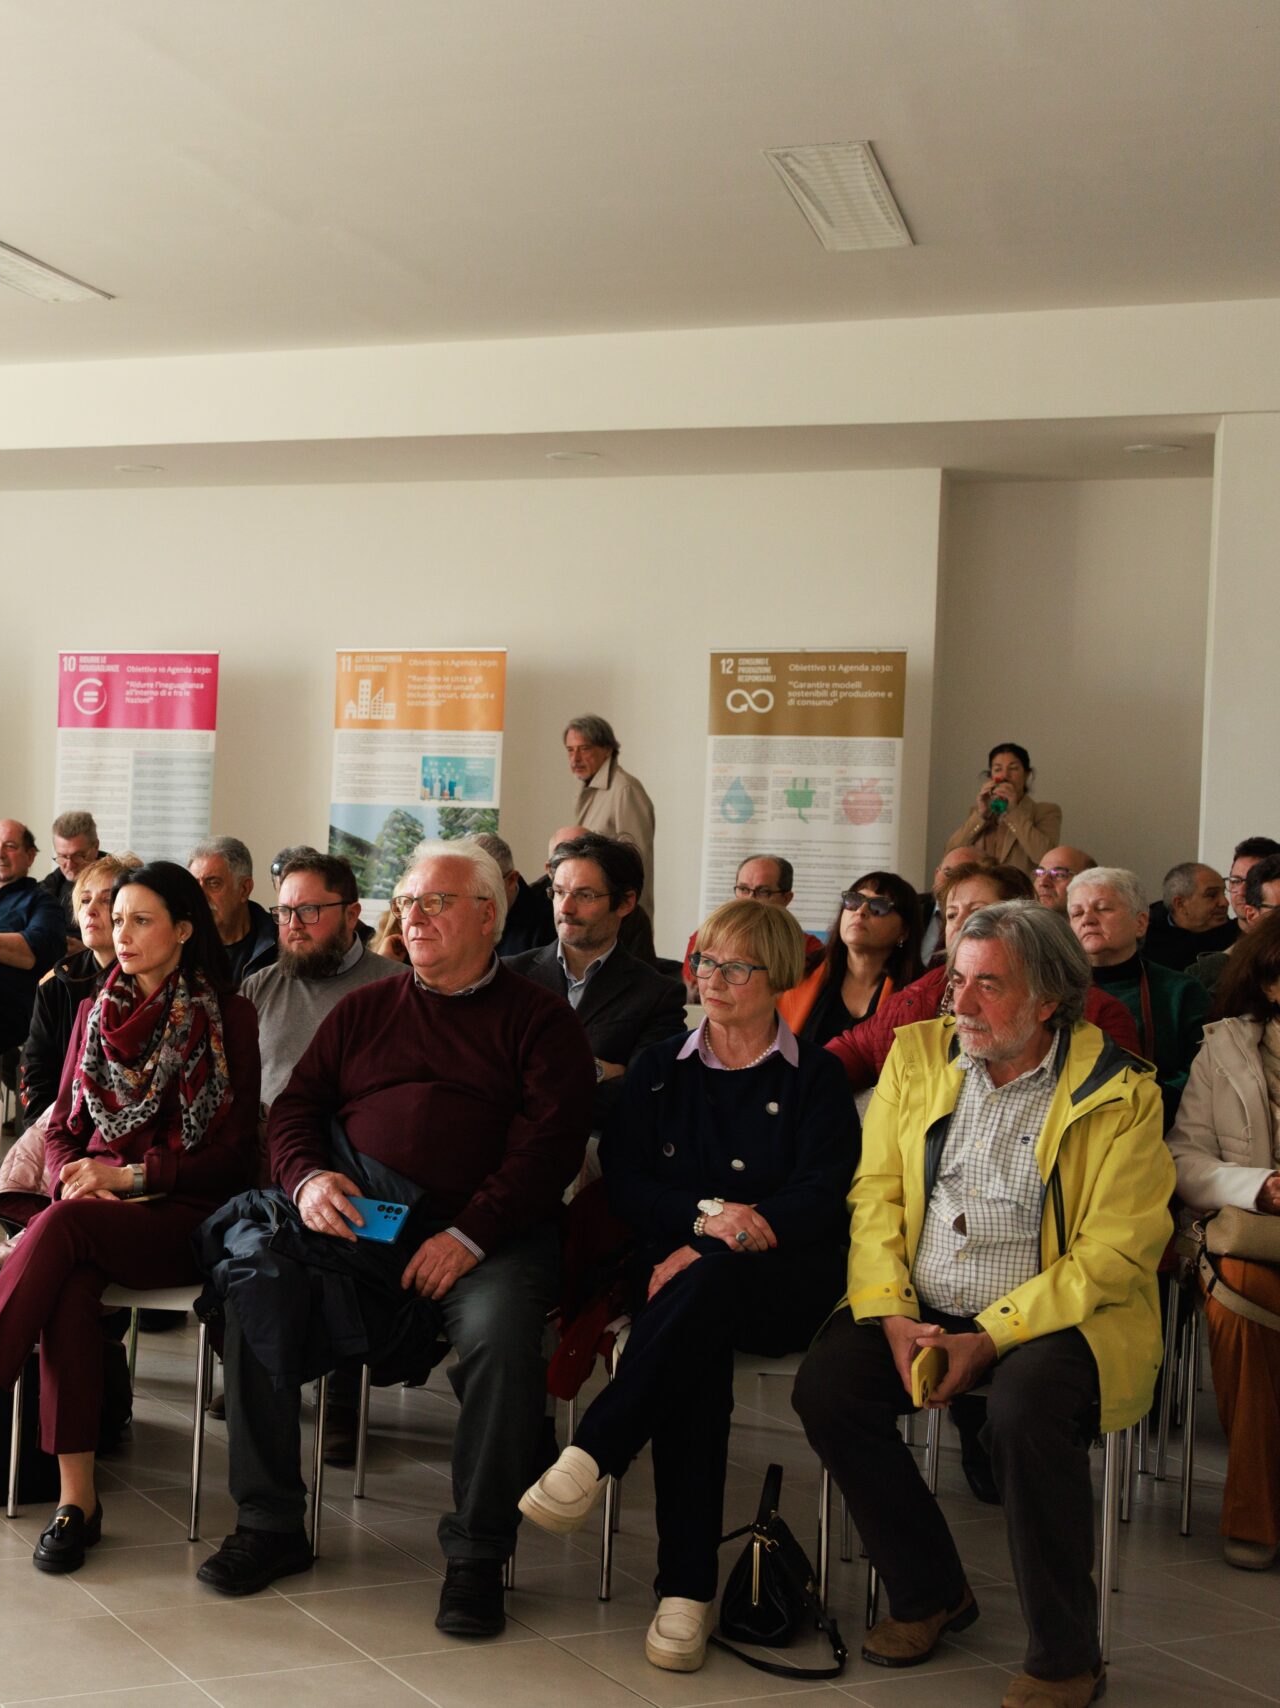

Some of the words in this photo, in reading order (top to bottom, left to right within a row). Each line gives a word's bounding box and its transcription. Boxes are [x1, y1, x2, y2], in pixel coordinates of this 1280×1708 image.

[63, 655, 76, 672] 10
[341, 655, 351, 673] 11
[720, 658, 734, 675] 12
[126, 665, 158, 673] Obiettivo
[167, 666, 192, 675] Agenda
[789, 664, 827, 672] Obiettivo
[837, 664, 870, 674] Agenda
[831, 681, 863, 689] modelli
[787, 690, 829, 698] sostenibili
[829, 690, 838, 698] di
[839, 690, 886, 700] produzione
